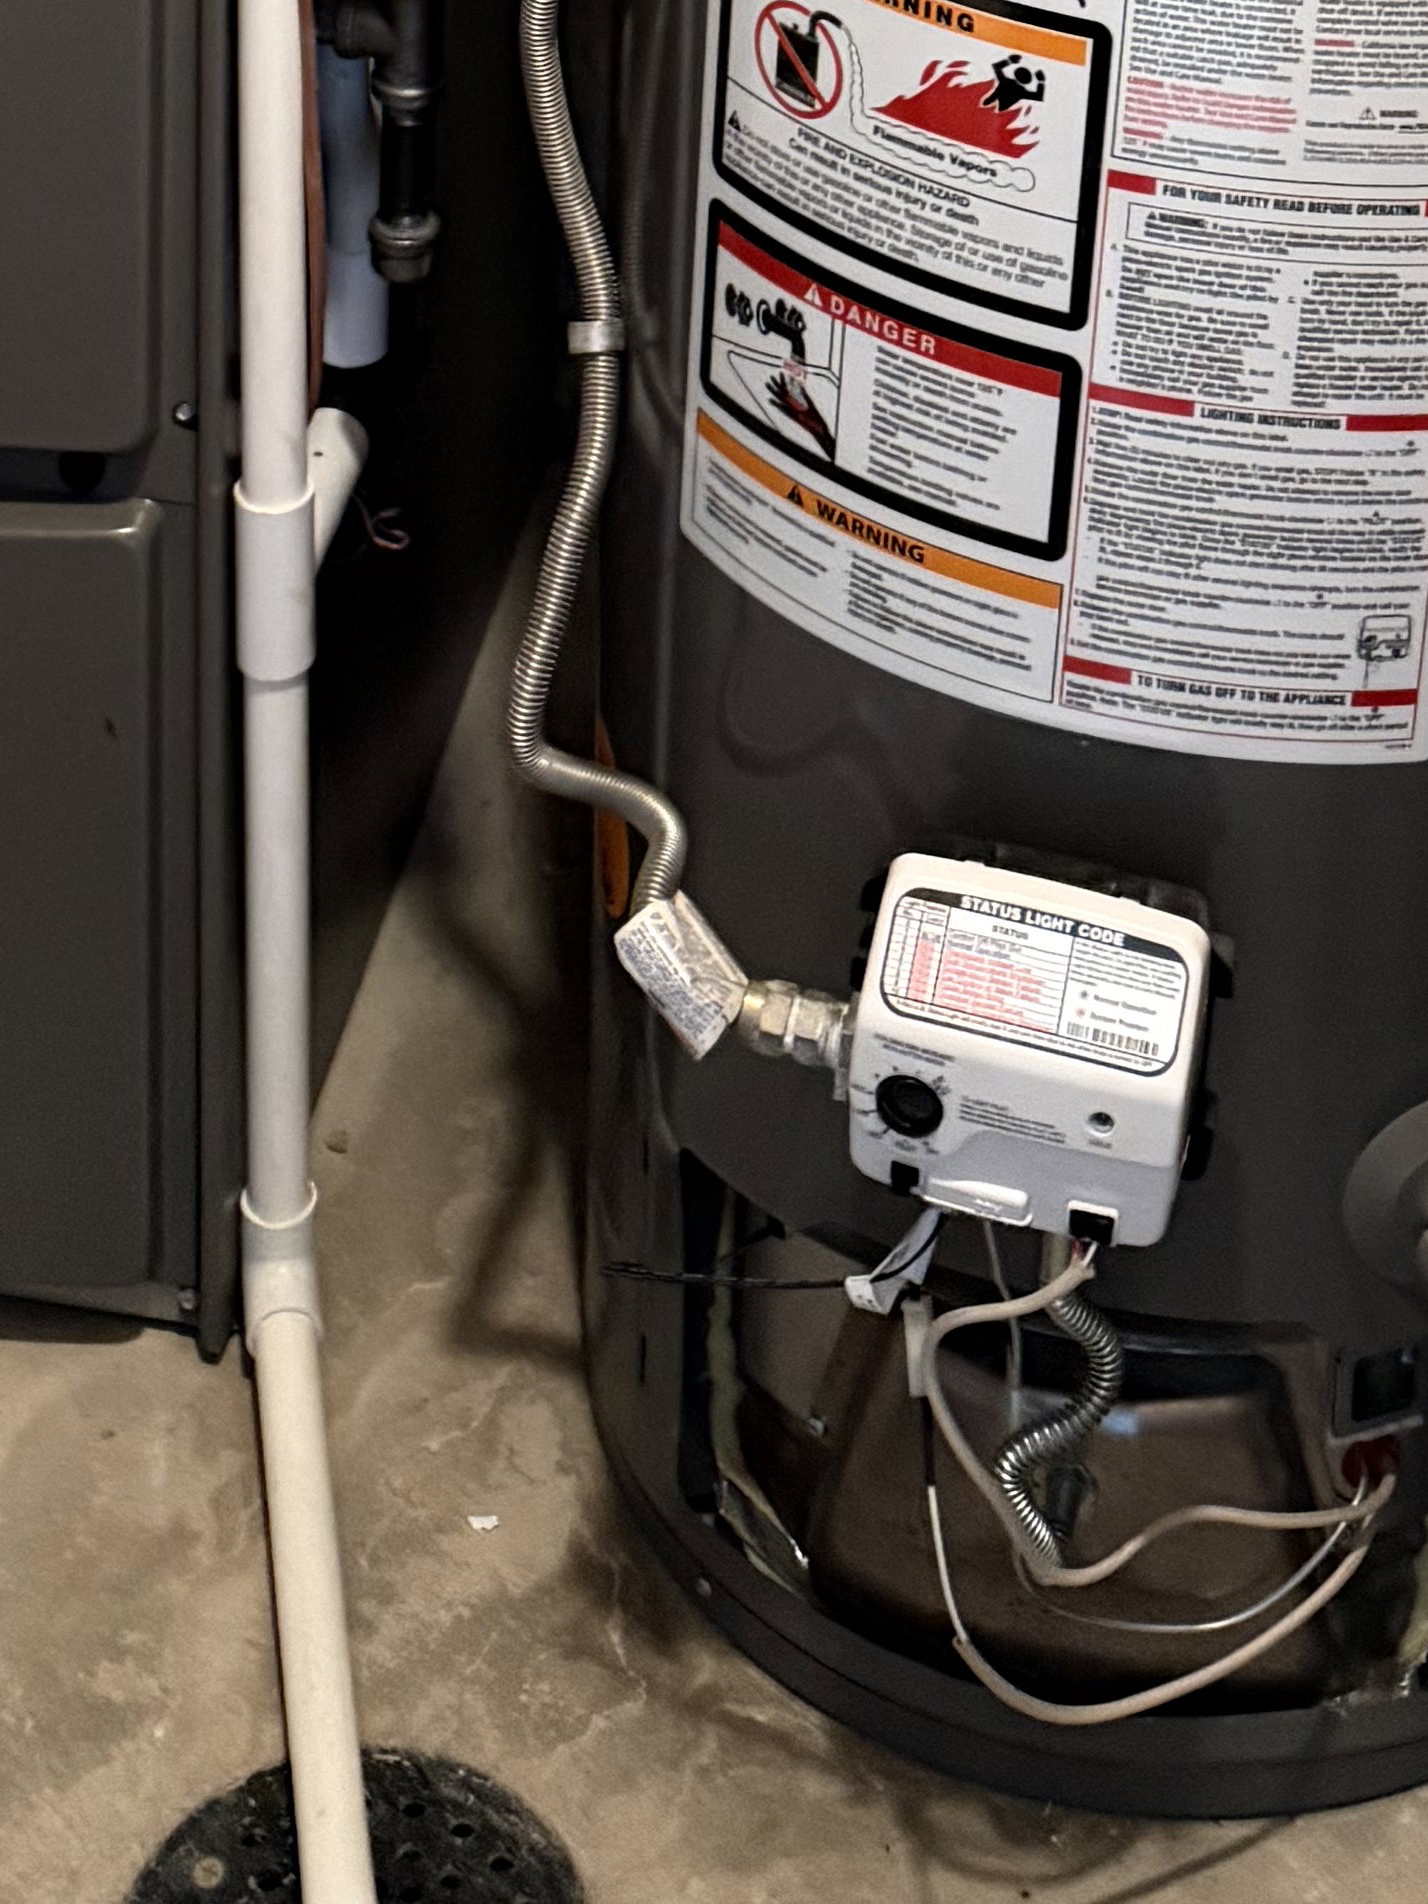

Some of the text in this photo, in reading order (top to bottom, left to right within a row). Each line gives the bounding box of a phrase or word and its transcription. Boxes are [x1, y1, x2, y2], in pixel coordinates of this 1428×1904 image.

[873, 124, 997, 177] Flammable Vapors
[1163, 184, 1421, 216] FOR YOUR SAFETY READ BEFORE OPERATING
[830, 296, 936, 356] DANGER
[1200, 407, 1341, 429] LIGHTING INSTRUCTIONS
[817, 498, 925, 565] WARNING
[1137, 675, 1152, 689] TO
[1156, 678, 1186, 693] TURN
[1189, 683, 1212, 696] GAS
[1215, 686, 1237, 699] OFF
[1241, 689, 1255, 701] TO
[1259, 690, 1280, 703] THE
[1283, 692, 1346, 706] APPLIANCE
[960, 896, 1125, 945] STATUS LIGHT CODE
[992, 924, 1029, 940] STATUS
